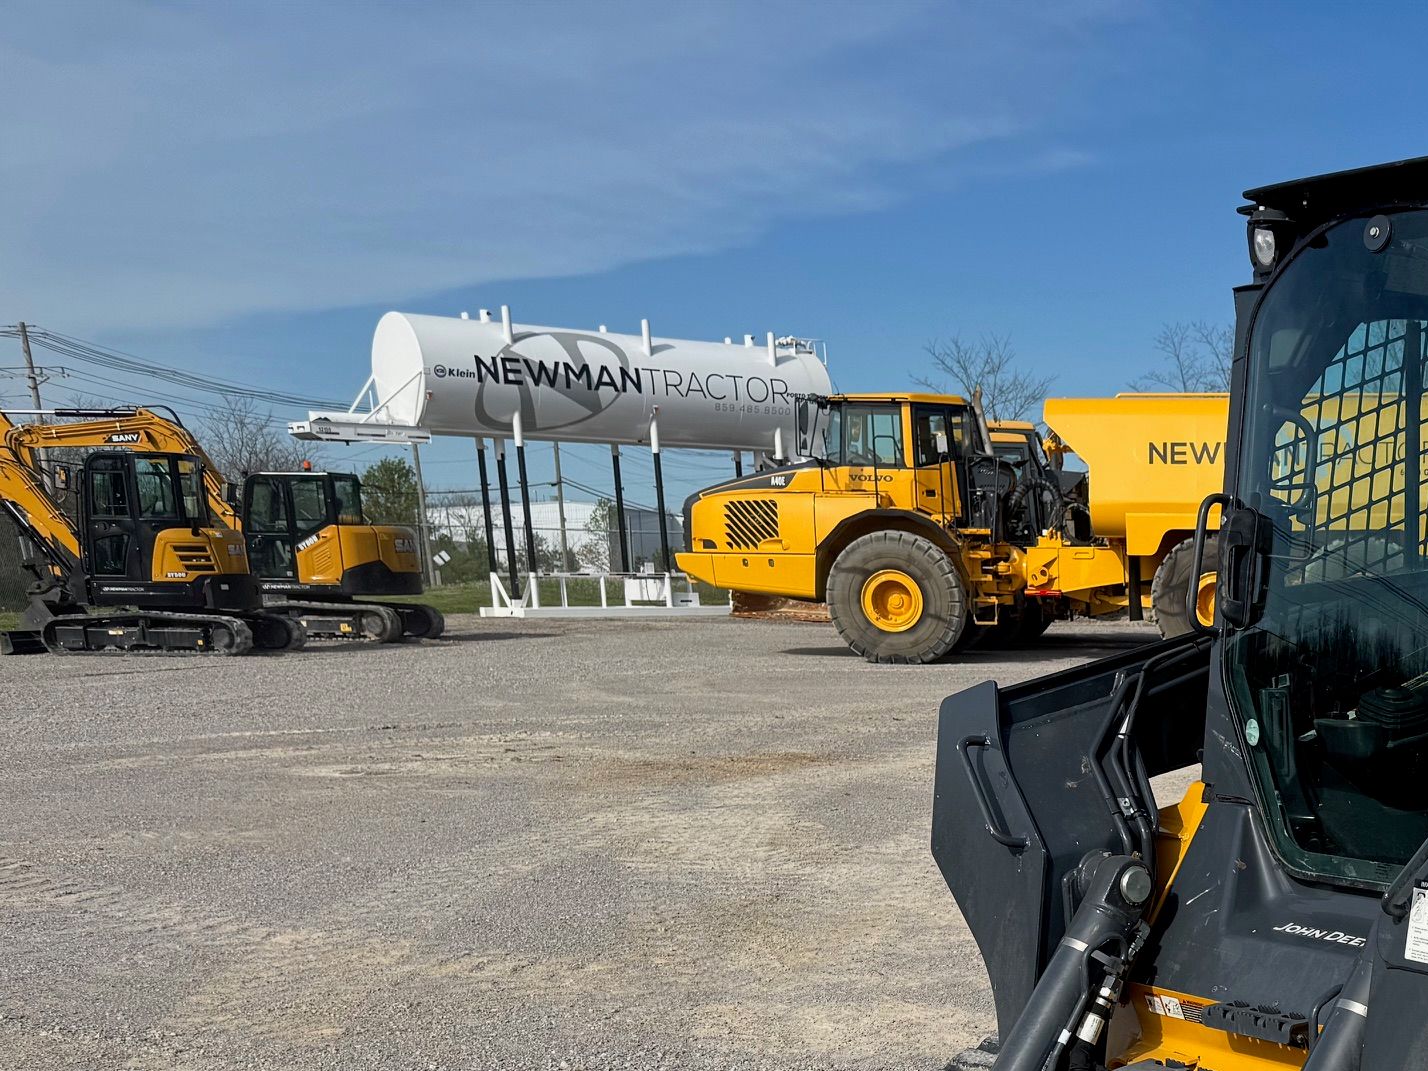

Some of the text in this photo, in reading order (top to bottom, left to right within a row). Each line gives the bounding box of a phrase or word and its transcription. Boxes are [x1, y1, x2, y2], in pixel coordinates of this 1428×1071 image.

[448, 368, 476, 378] Klein
[474, 354, 790, 405] NEWMANTRACTOR
[714, 402, 791, 416] 859.485.8500
[111, 433, 138, 442] SANY
[849, 473, 894, 482] VOLVO
[1273, 922, 1367, 947] JOHN DEE
